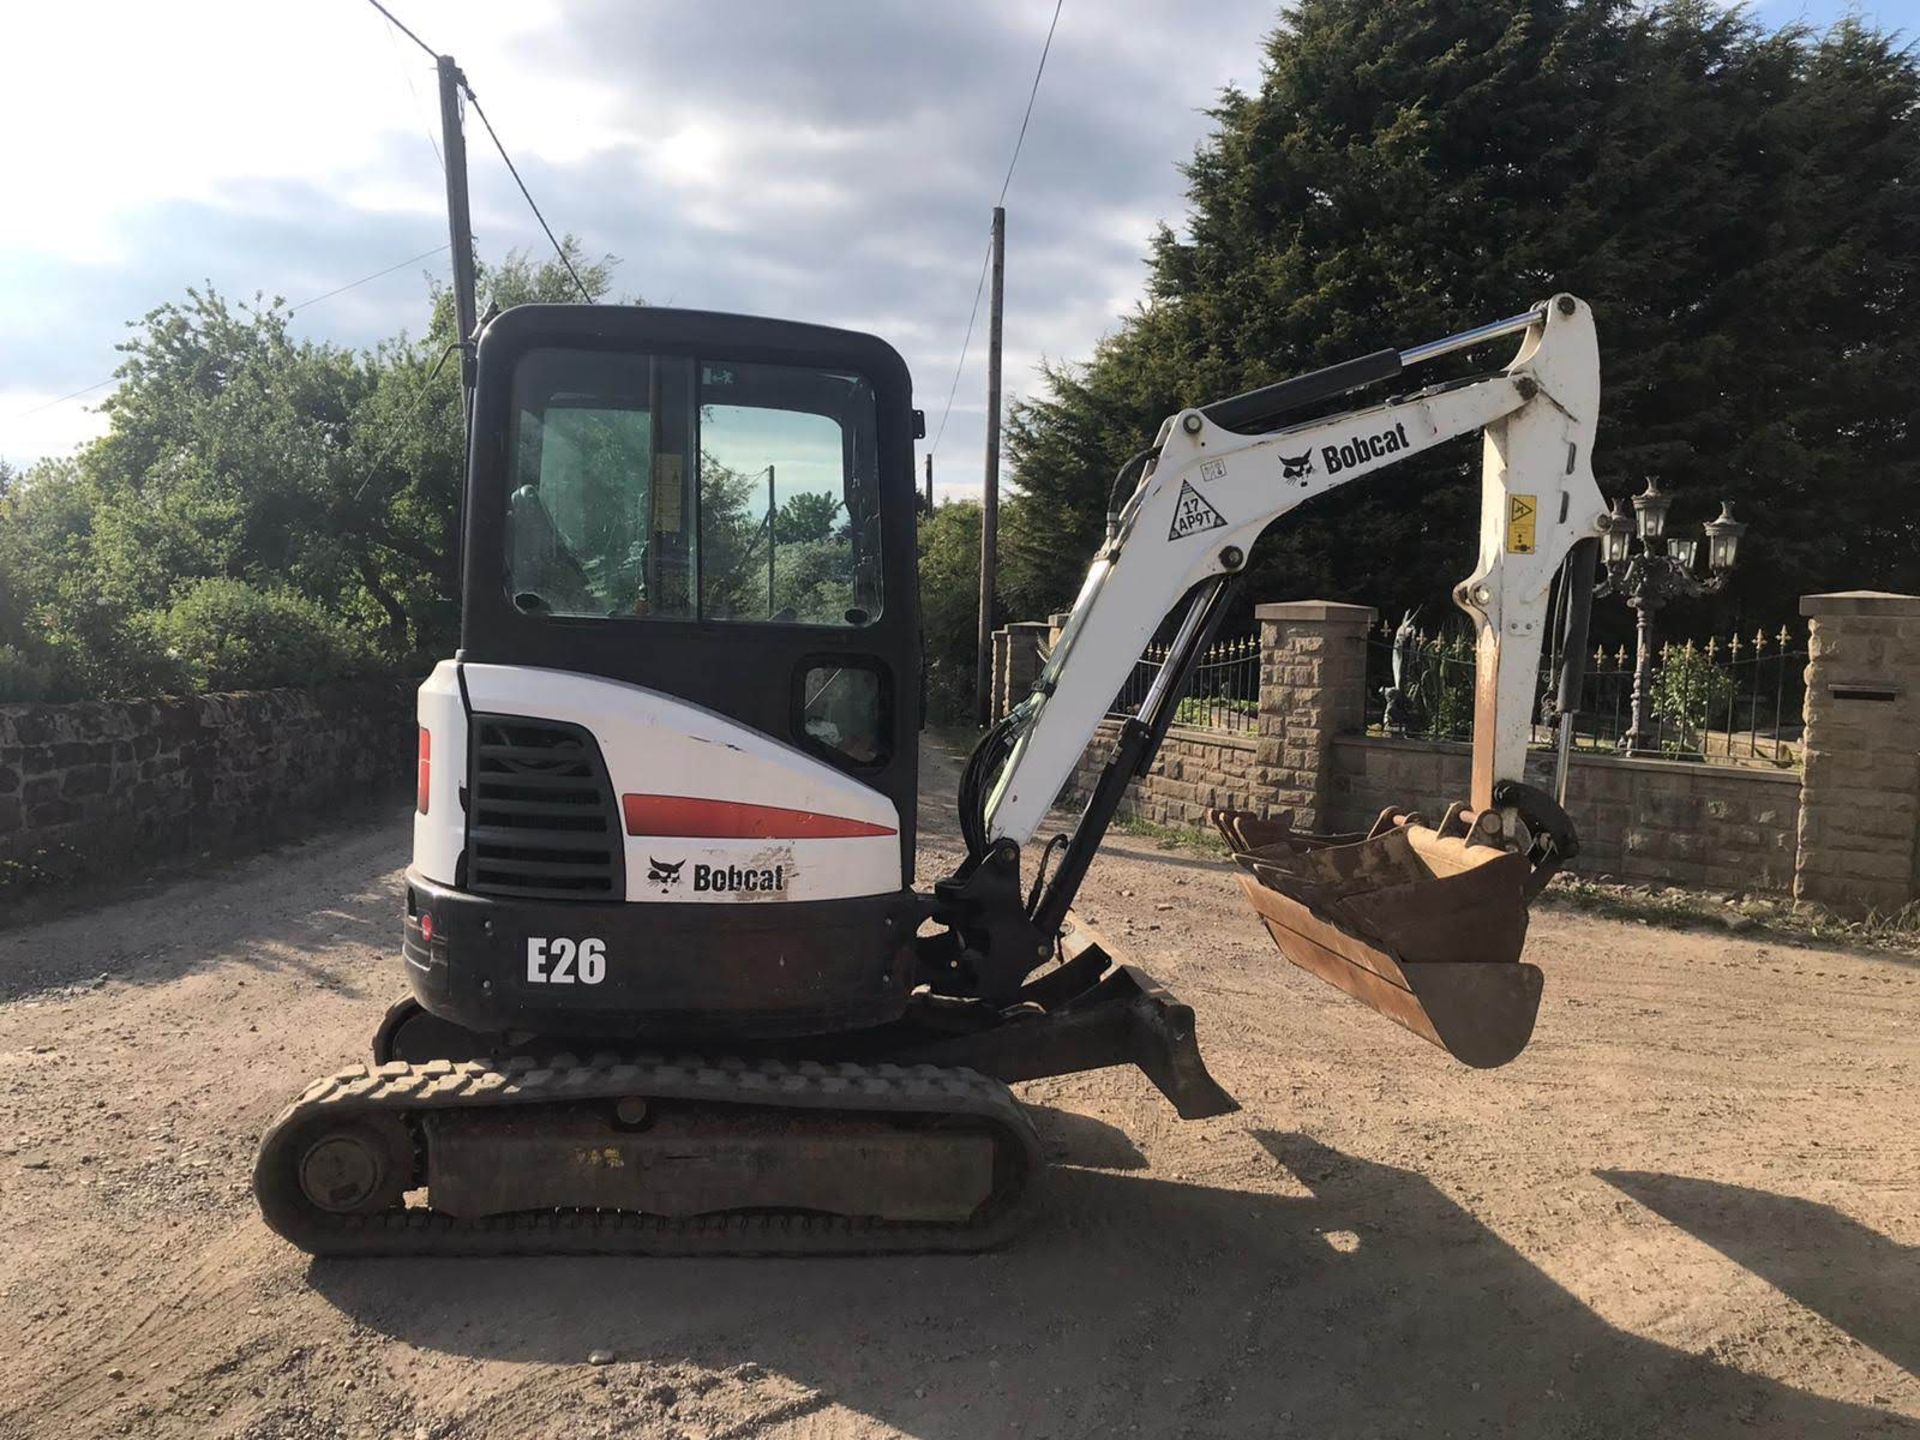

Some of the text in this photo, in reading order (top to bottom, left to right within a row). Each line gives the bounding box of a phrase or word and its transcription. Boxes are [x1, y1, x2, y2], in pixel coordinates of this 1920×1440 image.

[1321, 422, 1410, 475] Bobcat
[1179, 510, 1211, 531] AP9T
[1183, 498, 1199, 515] 17
[694, 864, 784, 892] Bobcat
[527, 937, 606, 984] E26
